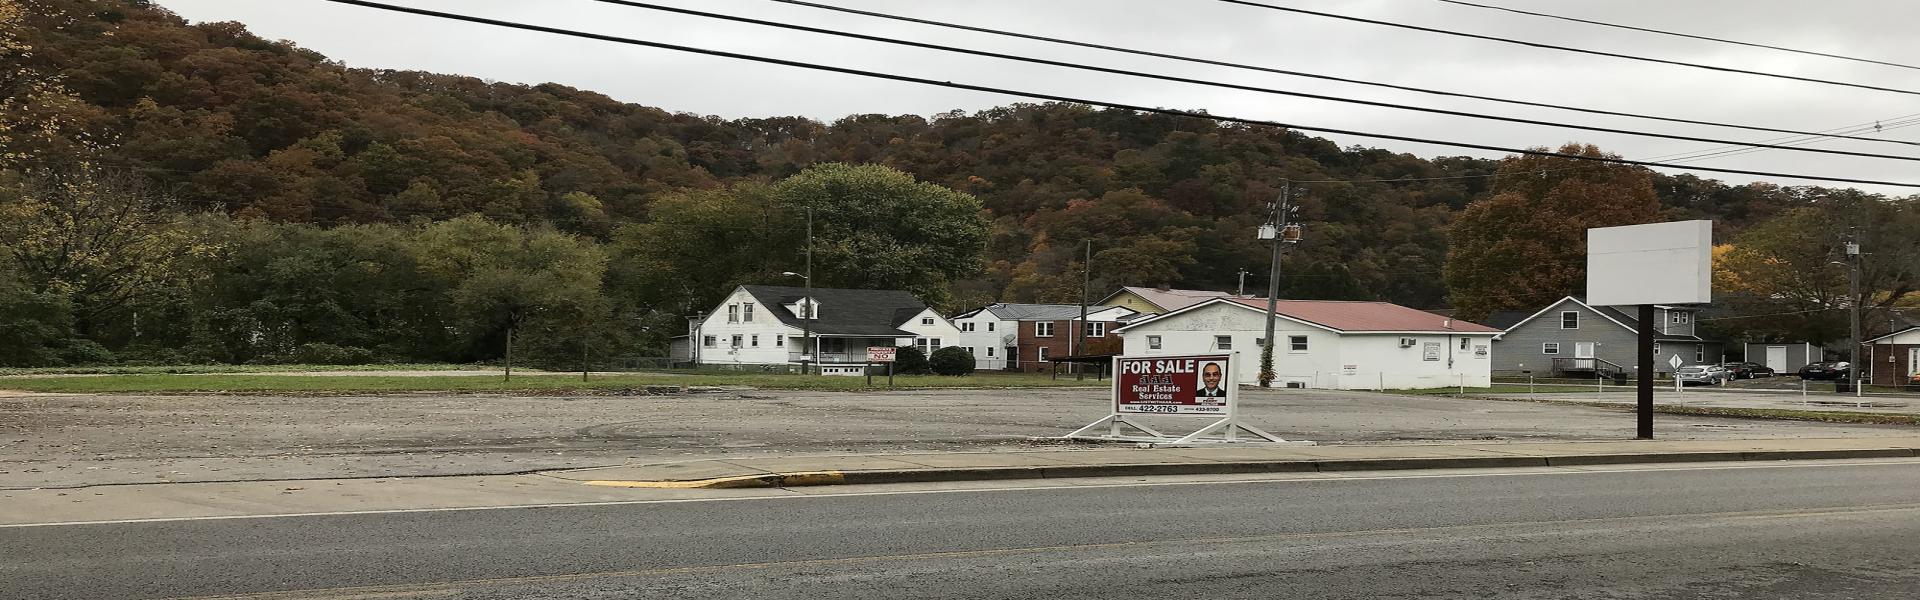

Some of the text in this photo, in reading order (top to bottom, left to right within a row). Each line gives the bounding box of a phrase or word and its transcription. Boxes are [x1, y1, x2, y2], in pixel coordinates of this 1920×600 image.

[1122, 360, 1195, 374] FOR SALE
[1132, 384, 1181, 393] Real Estate
[1138, 392, 1173, 400] Services
